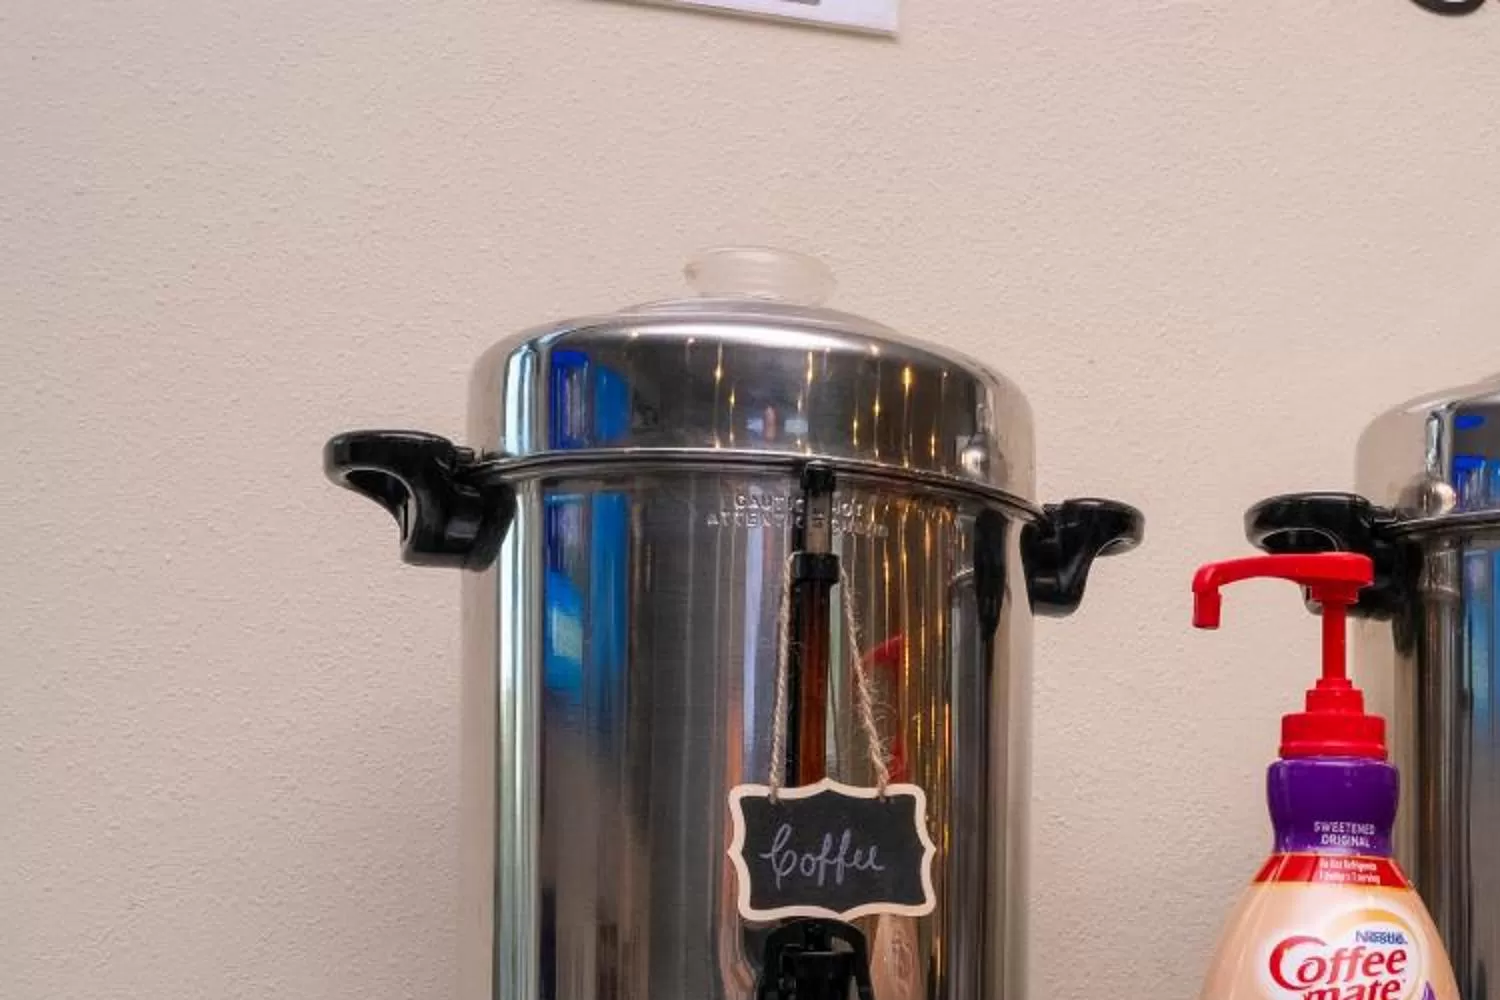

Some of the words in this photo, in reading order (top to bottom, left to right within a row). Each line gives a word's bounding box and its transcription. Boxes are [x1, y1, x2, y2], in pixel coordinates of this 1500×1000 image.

[734, 495, 804, 512] CAUTIO
[706, 511, 804, 528] ATTENTIO
[1313, 821, 1376, 835] SWEETENED
[1321, 833, 1371, 849] ORIGINAL
[760, 824, 885, 891] Coffee
[1269, 935, 1407, 991] Coffee
